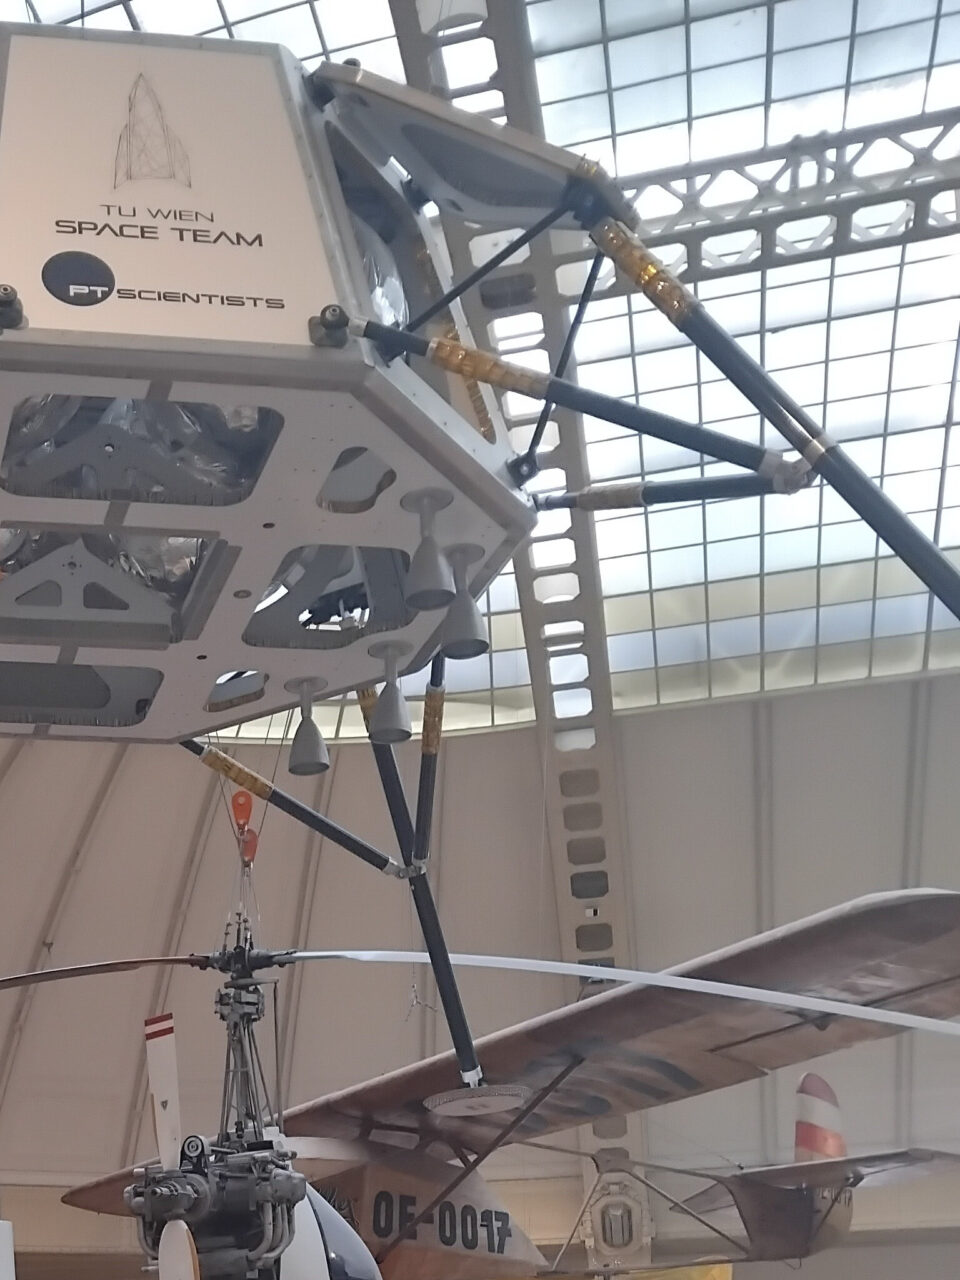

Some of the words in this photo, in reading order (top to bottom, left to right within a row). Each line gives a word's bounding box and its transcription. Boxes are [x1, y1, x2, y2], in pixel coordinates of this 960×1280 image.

[100, 204, 136, 217] TU
[147, 207, 214, 223] WIEN
[55, 219, 159, 240] SPACE
[170, 226, 263, 247] TEAM
